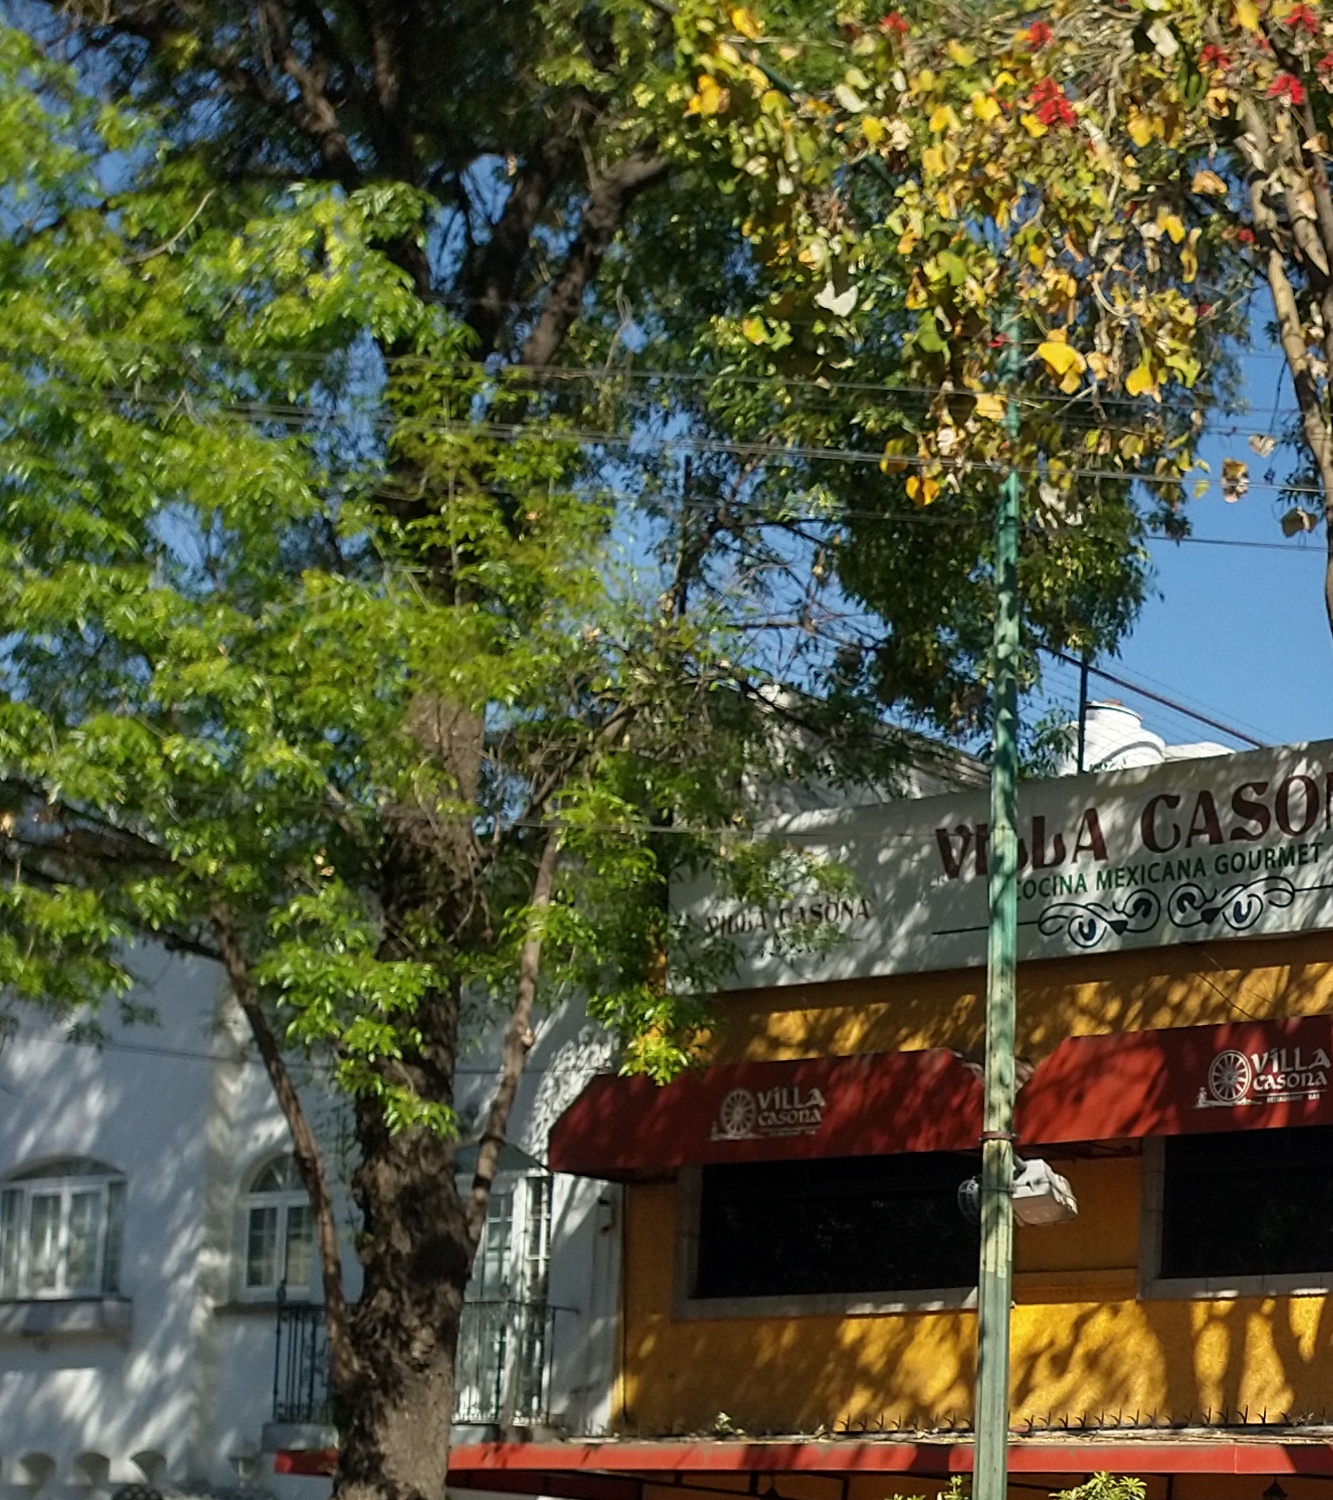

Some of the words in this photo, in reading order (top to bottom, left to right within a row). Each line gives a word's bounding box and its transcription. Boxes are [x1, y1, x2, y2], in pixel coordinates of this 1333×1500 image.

[1016, 872, 1088, 901] OCINA
[1096, 855, 1207, 891] MEXICANA
[1215, 841, 1324, 875] GOURMET
